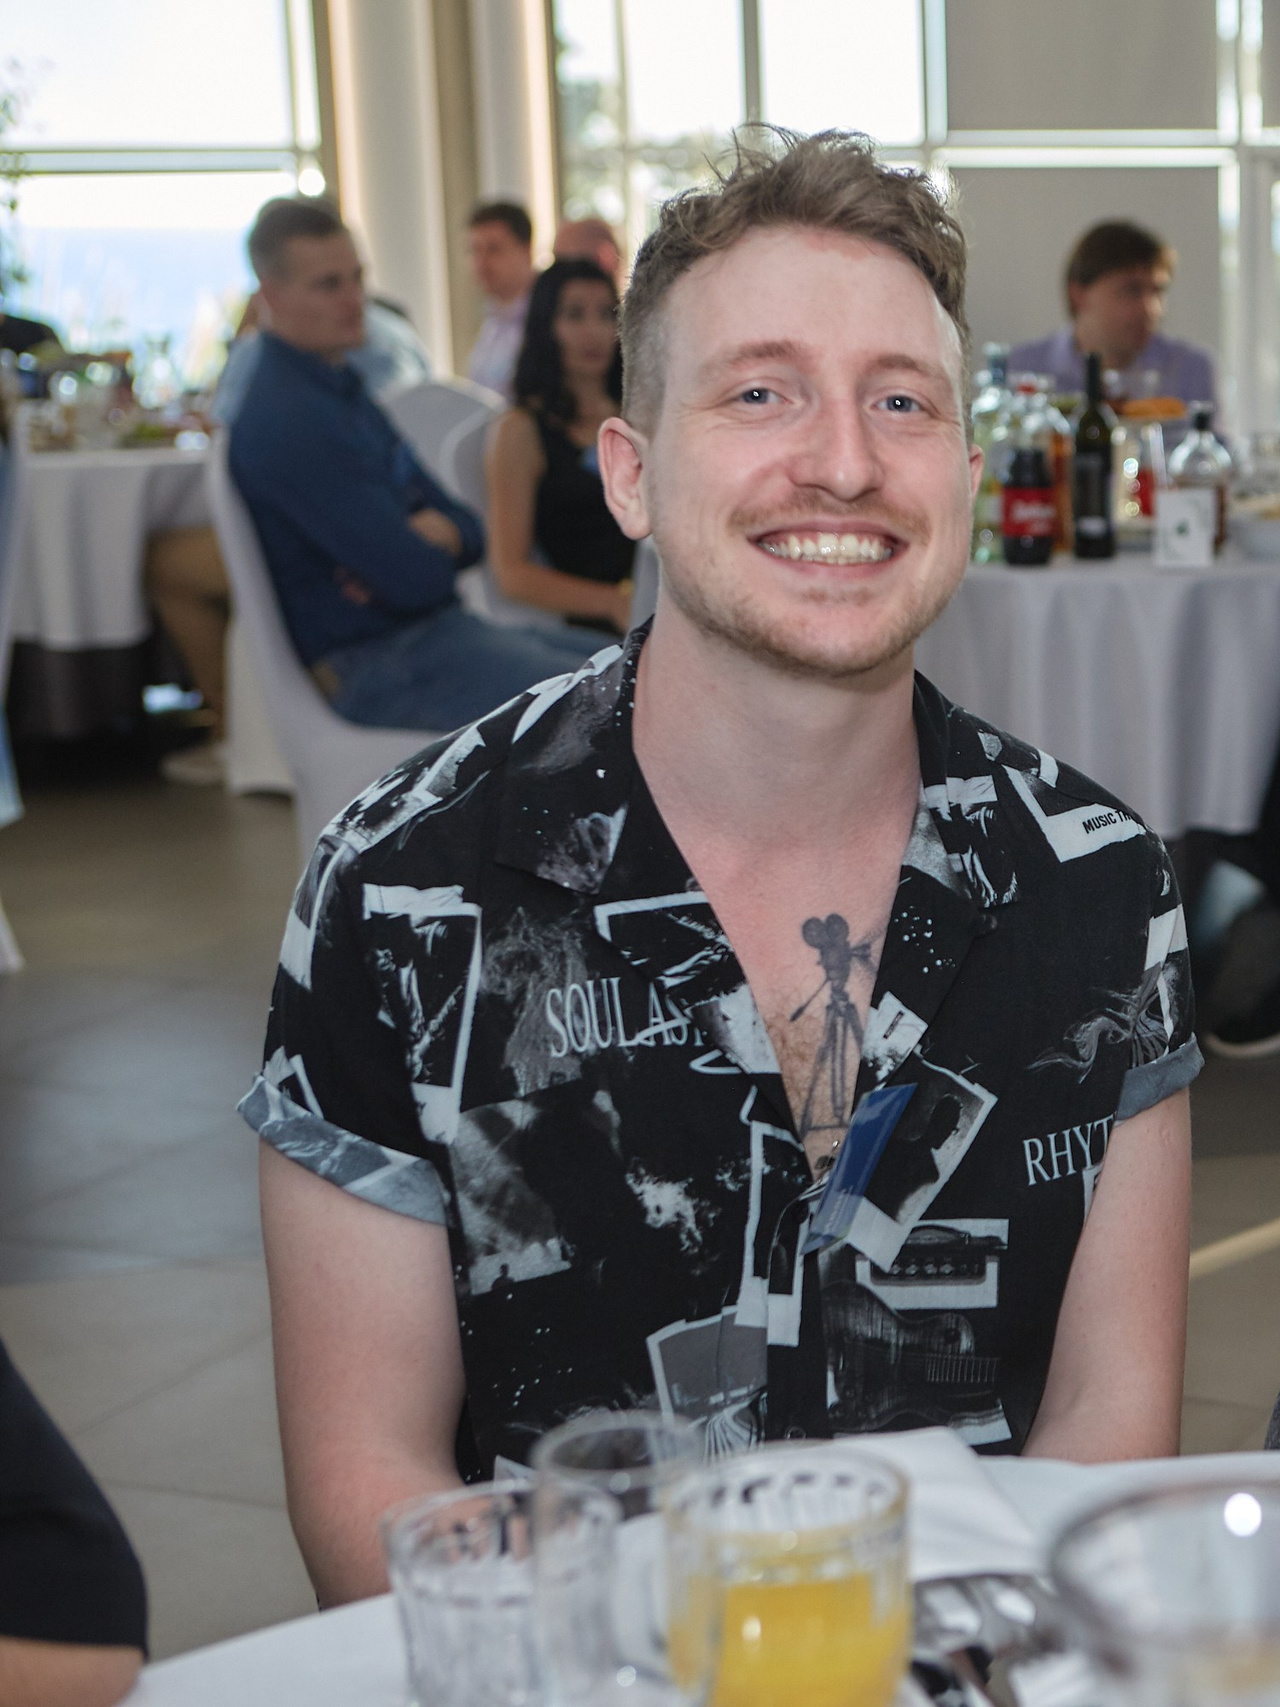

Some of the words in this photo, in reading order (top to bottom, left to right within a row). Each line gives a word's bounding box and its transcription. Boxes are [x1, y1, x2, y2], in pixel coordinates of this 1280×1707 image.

[1082, 812, 1117, 834] MUSIC
[545, 976, 637, 1058] SOUL
[1023, 1111, 1117, 1186] RHYT
